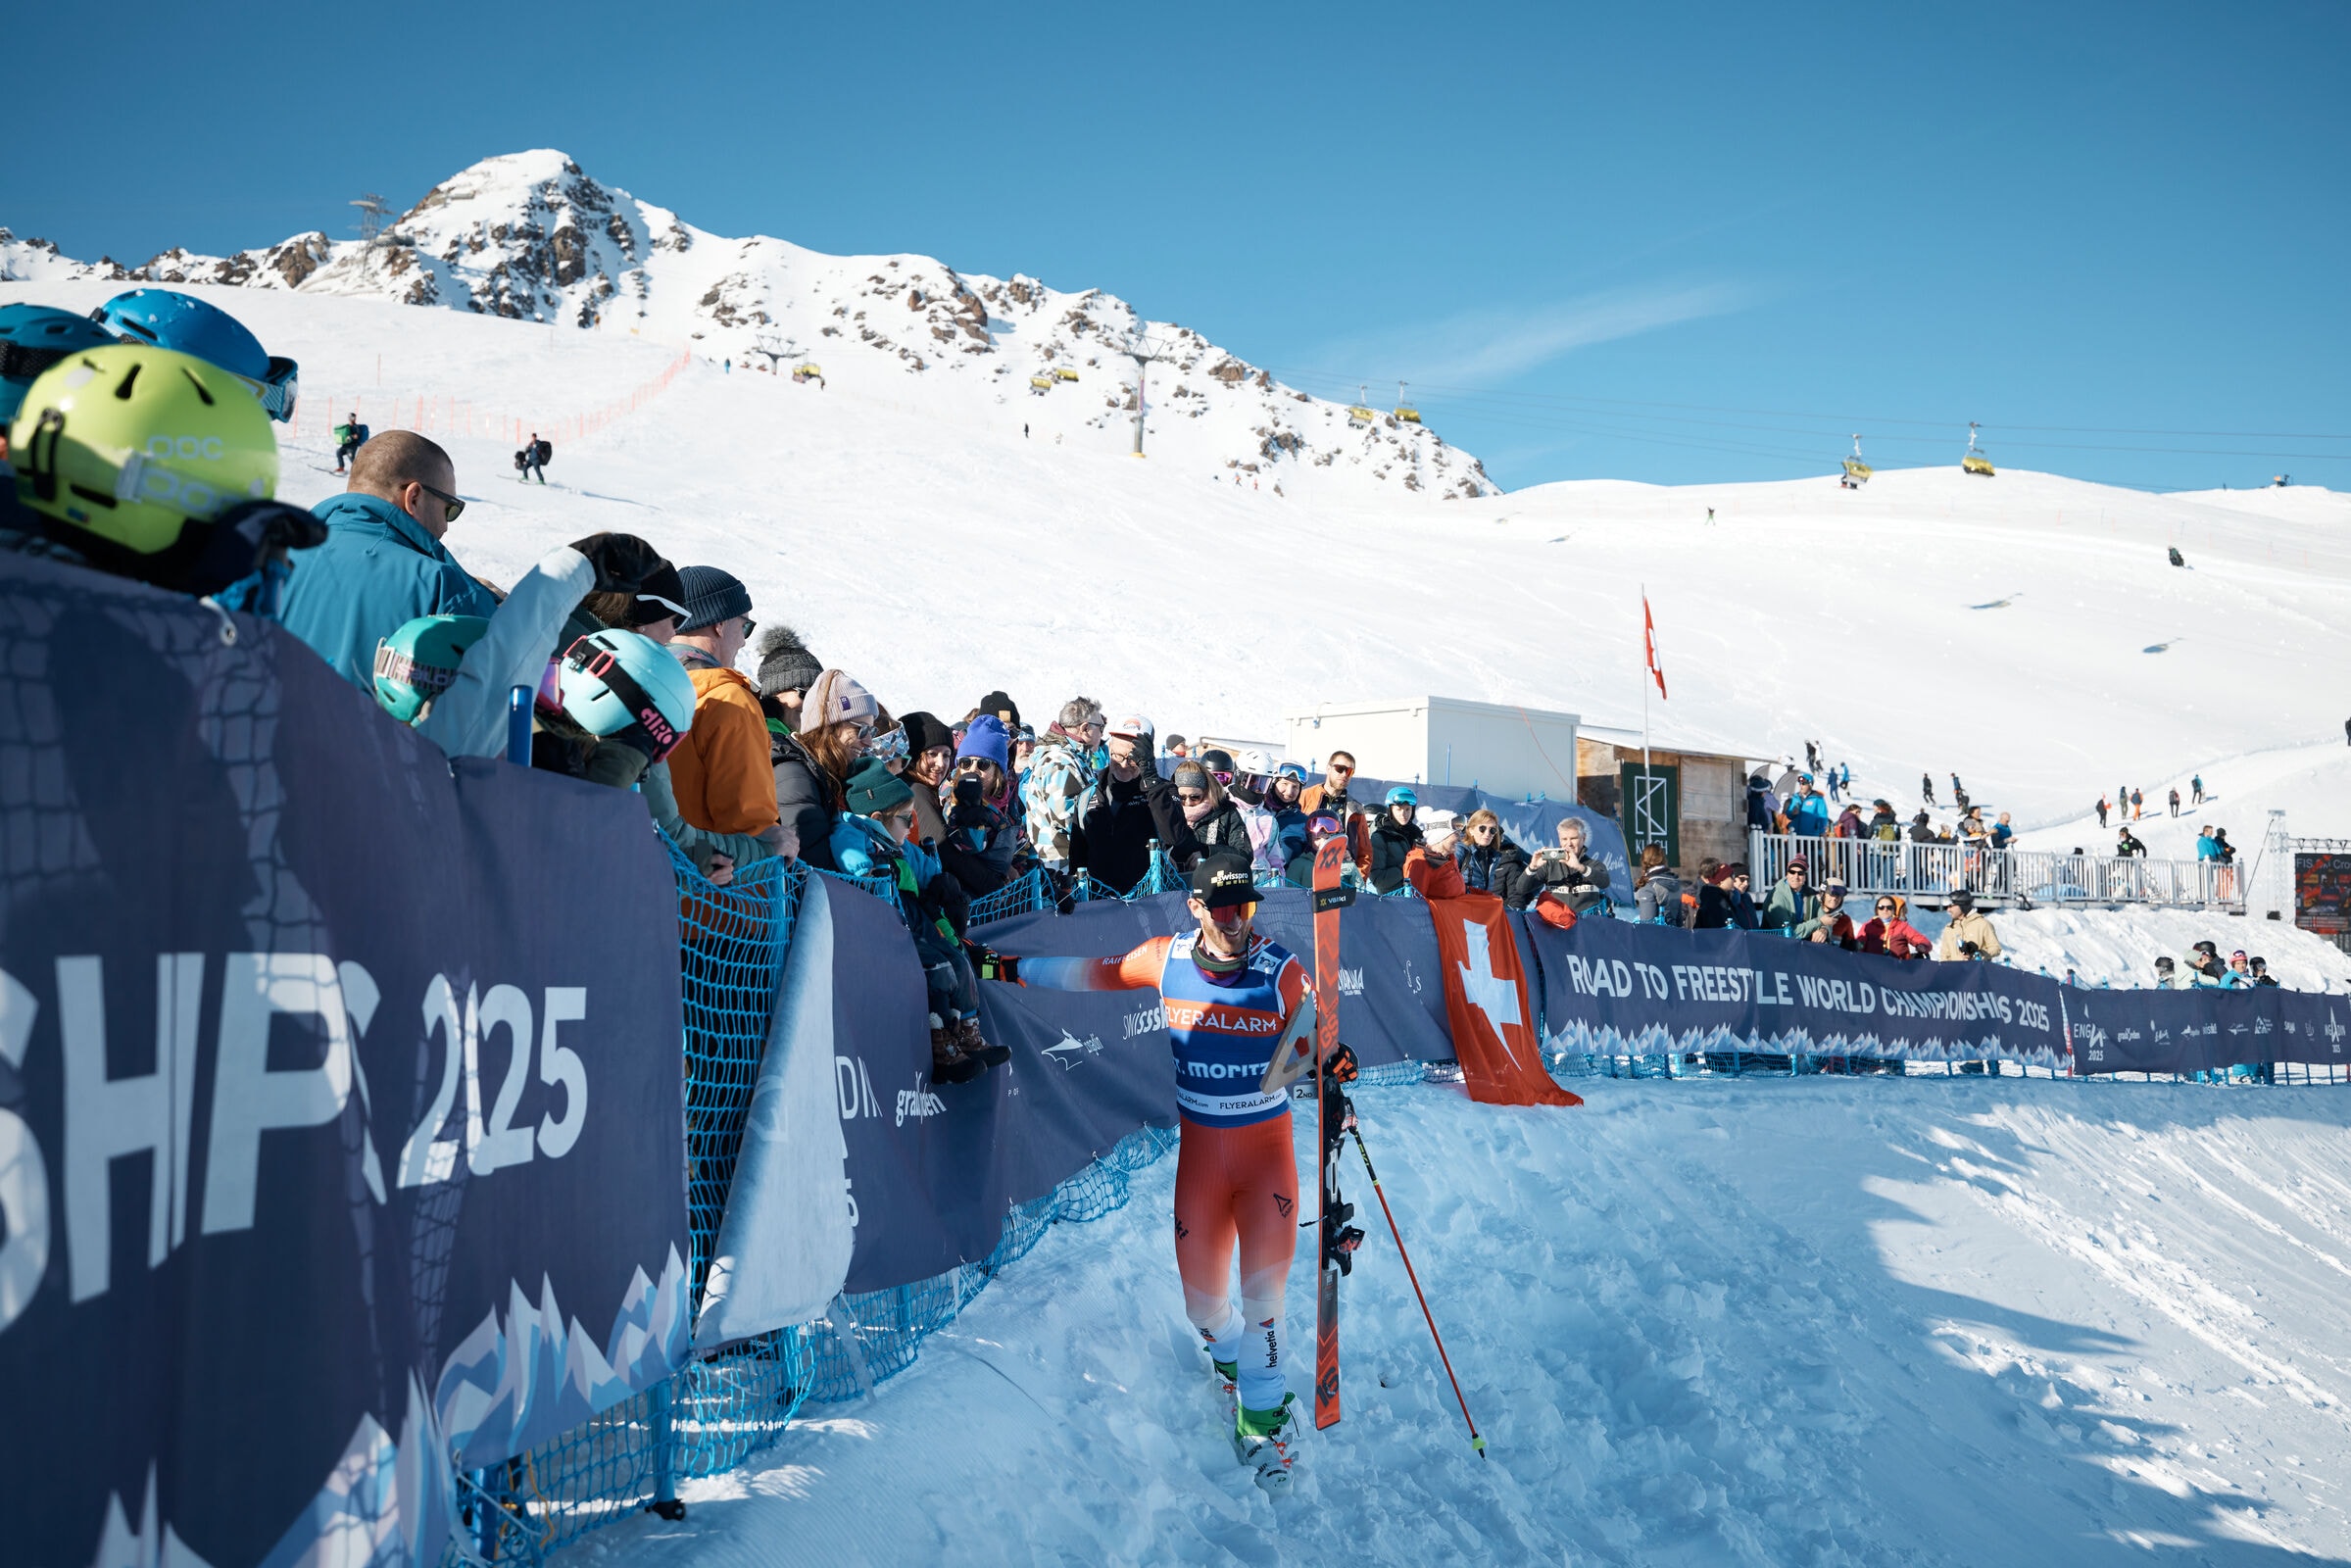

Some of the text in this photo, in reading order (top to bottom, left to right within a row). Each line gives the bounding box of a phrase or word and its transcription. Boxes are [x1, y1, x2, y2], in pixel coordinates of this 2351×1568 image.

[640, 707, 673, 745] GIRO
[2333, 858, 2351, 870] Cro
[1216, 872, 1249, 885] swisspro
[1566, 954, 1633, 998] ROAD
[1634, 961, 1669, 1000] TO
[1795, 974, 1877, 1014] WORLD
[1880, 985, 2013, 1025] CHAMPIONSHIS
[2015, 999, 2050, 1032] 2025
[2087, 1050, 2104, 1061] 2025
[1296, 1088, 1313, 1100] 2ND
[1265, 1329, 1278, 1369] helvetia
